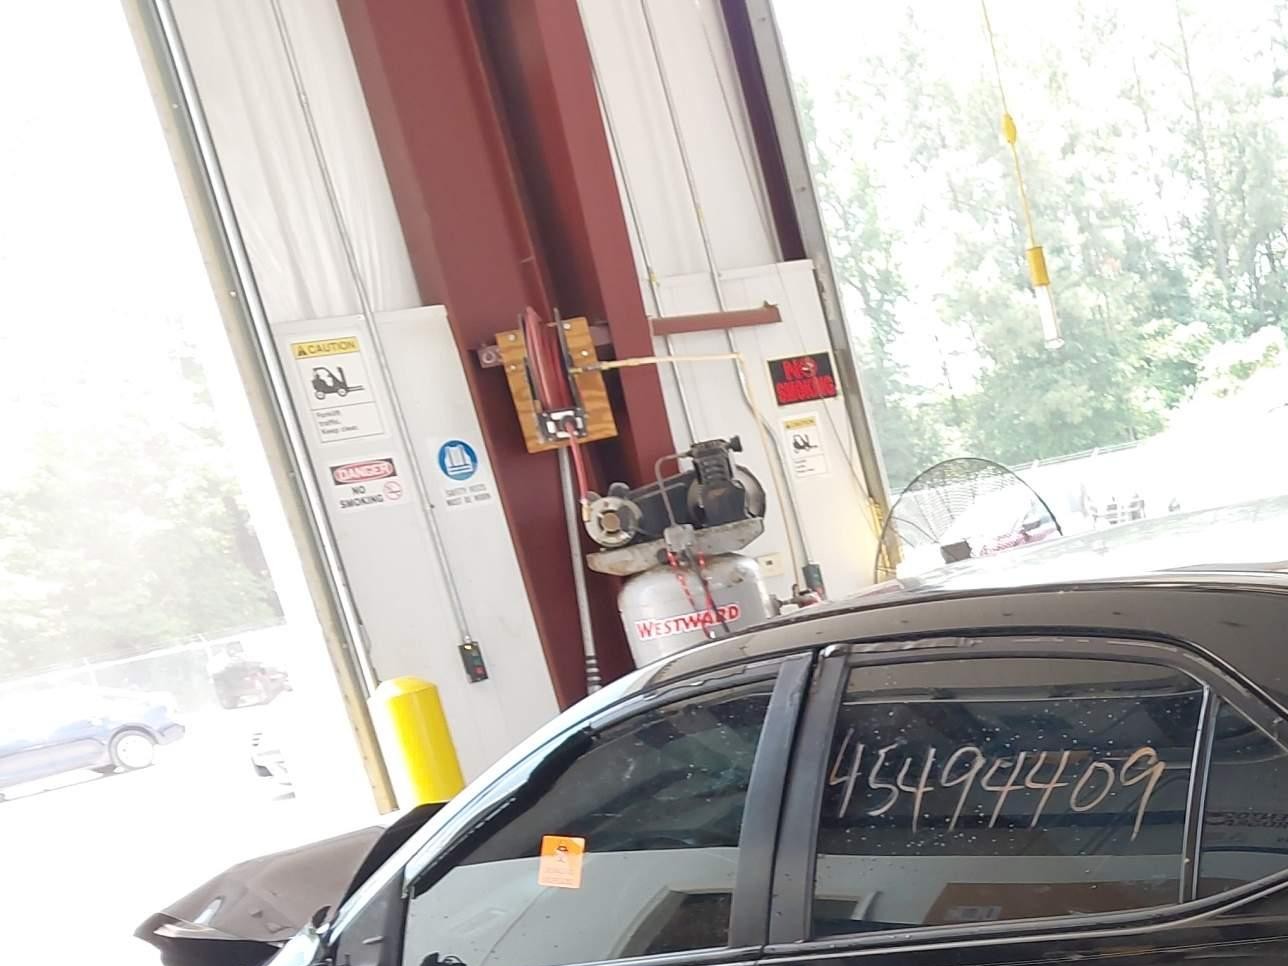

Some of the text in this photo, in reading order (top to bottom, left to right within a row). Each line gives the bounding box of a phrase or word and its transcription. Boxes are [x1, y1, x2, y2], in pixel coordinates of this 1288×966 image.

[307, 341, 356, 355] CAUTION
[783, 357, 816, 380] NO
[337, 464, 390, 481] DANGER
[352, 485, 367, 495] NO
[340, 494, 385, 509] SMOKING
[636, 604, 740, 639] WESTWARD
[829, 728, 1167, 841] 45494409
